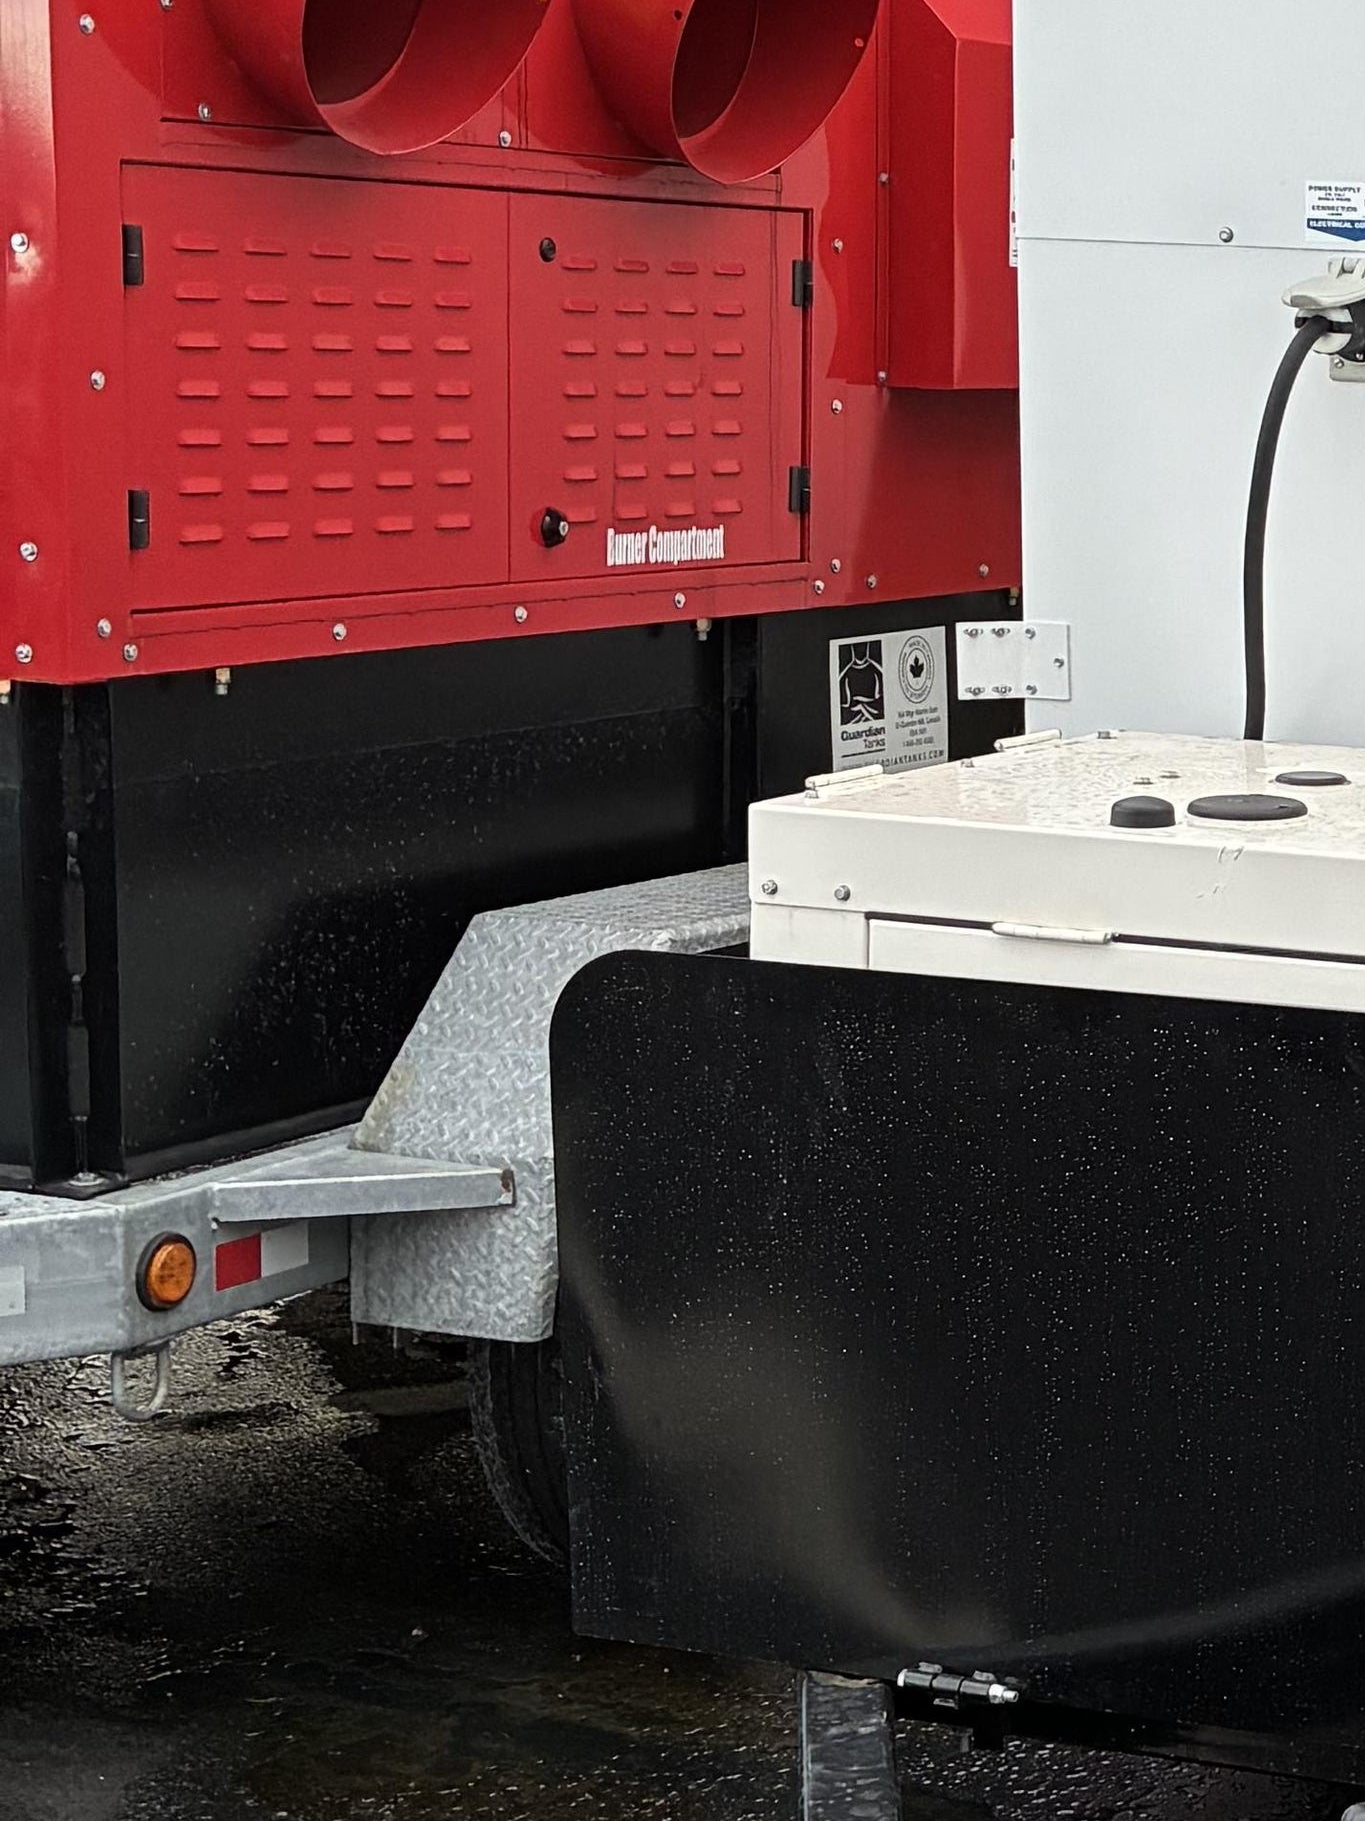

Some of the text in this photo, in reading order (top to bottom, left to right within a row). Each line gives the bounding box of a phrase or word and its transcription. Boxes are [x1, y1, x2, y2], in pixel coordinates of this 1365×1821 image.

[607, 524, 725, 566] Burner Compartment
[841, 726, 886, 741] Guardian
